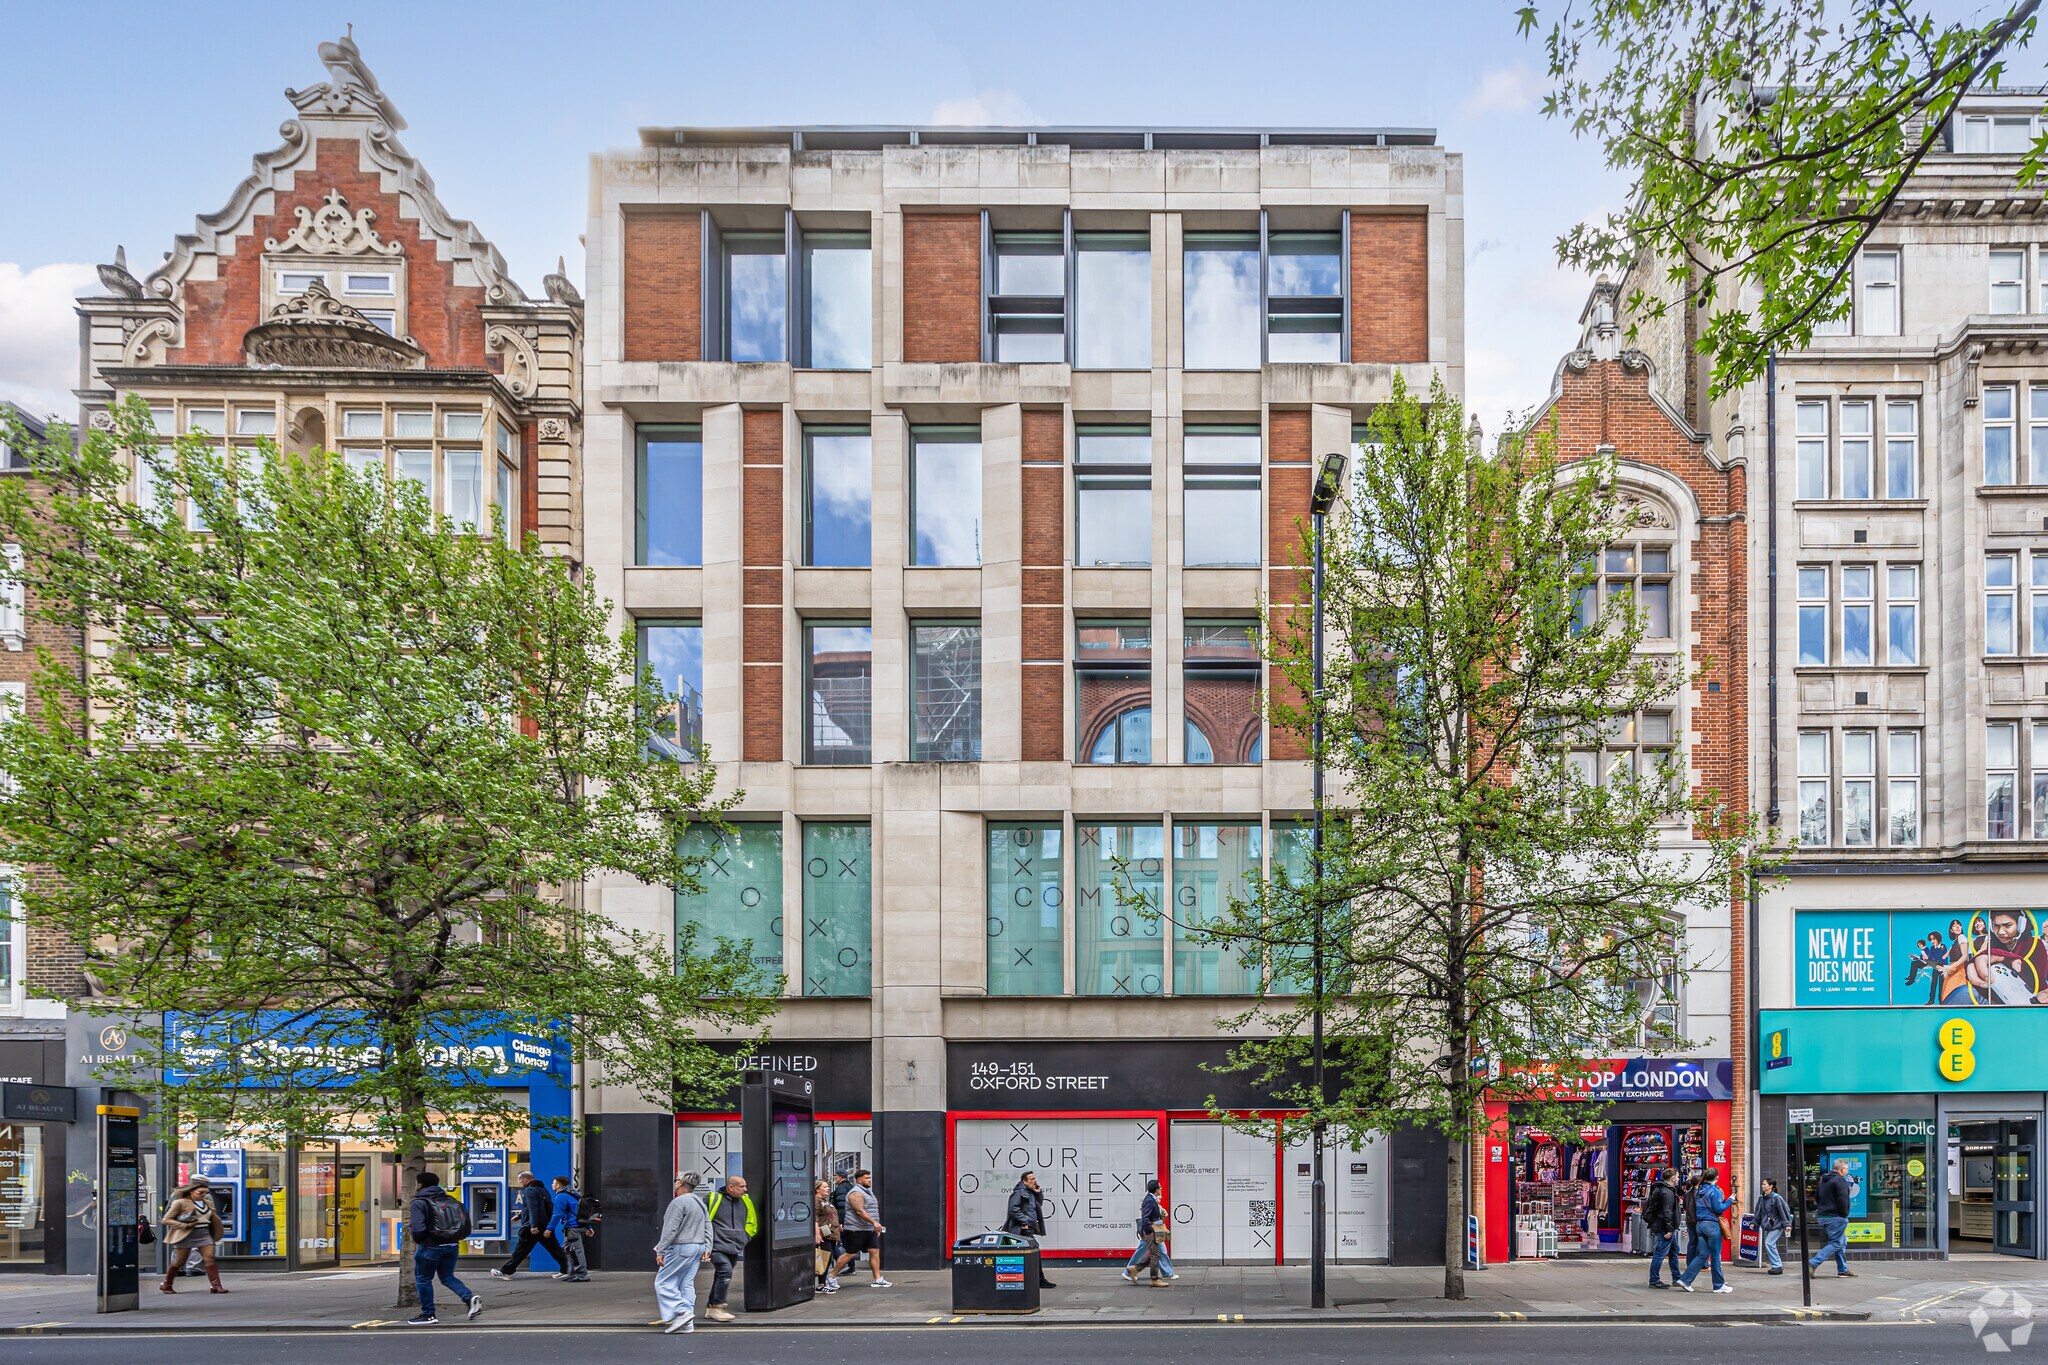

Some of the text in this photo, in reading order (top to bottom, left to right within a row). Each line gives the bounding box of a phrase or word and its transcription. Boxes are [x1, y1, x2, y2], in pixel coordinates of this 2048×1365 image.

[1808, 928, 1875, 959] NEW EE
[1808, 960, 1875, 983] DOES MORE
[393, 1038, 510, 1075] oney
[512, 1038, 552, 1058] Change
[514, 1052, 549, 1071] Money
[734, 1055, 818, 1072] DEFINED
[970, 1076, 1109, 1090] OXFORD STREET
[1622, 1070, 1709, 1088] LONDON
[985, 1147, 1079, 1169] YOUR
[1062, 1172, 1154, 1194] NEXT
[1742, 1234, 1758, 1242] MONEY
[1740, 1248, 1758, 1257] CHANGE
